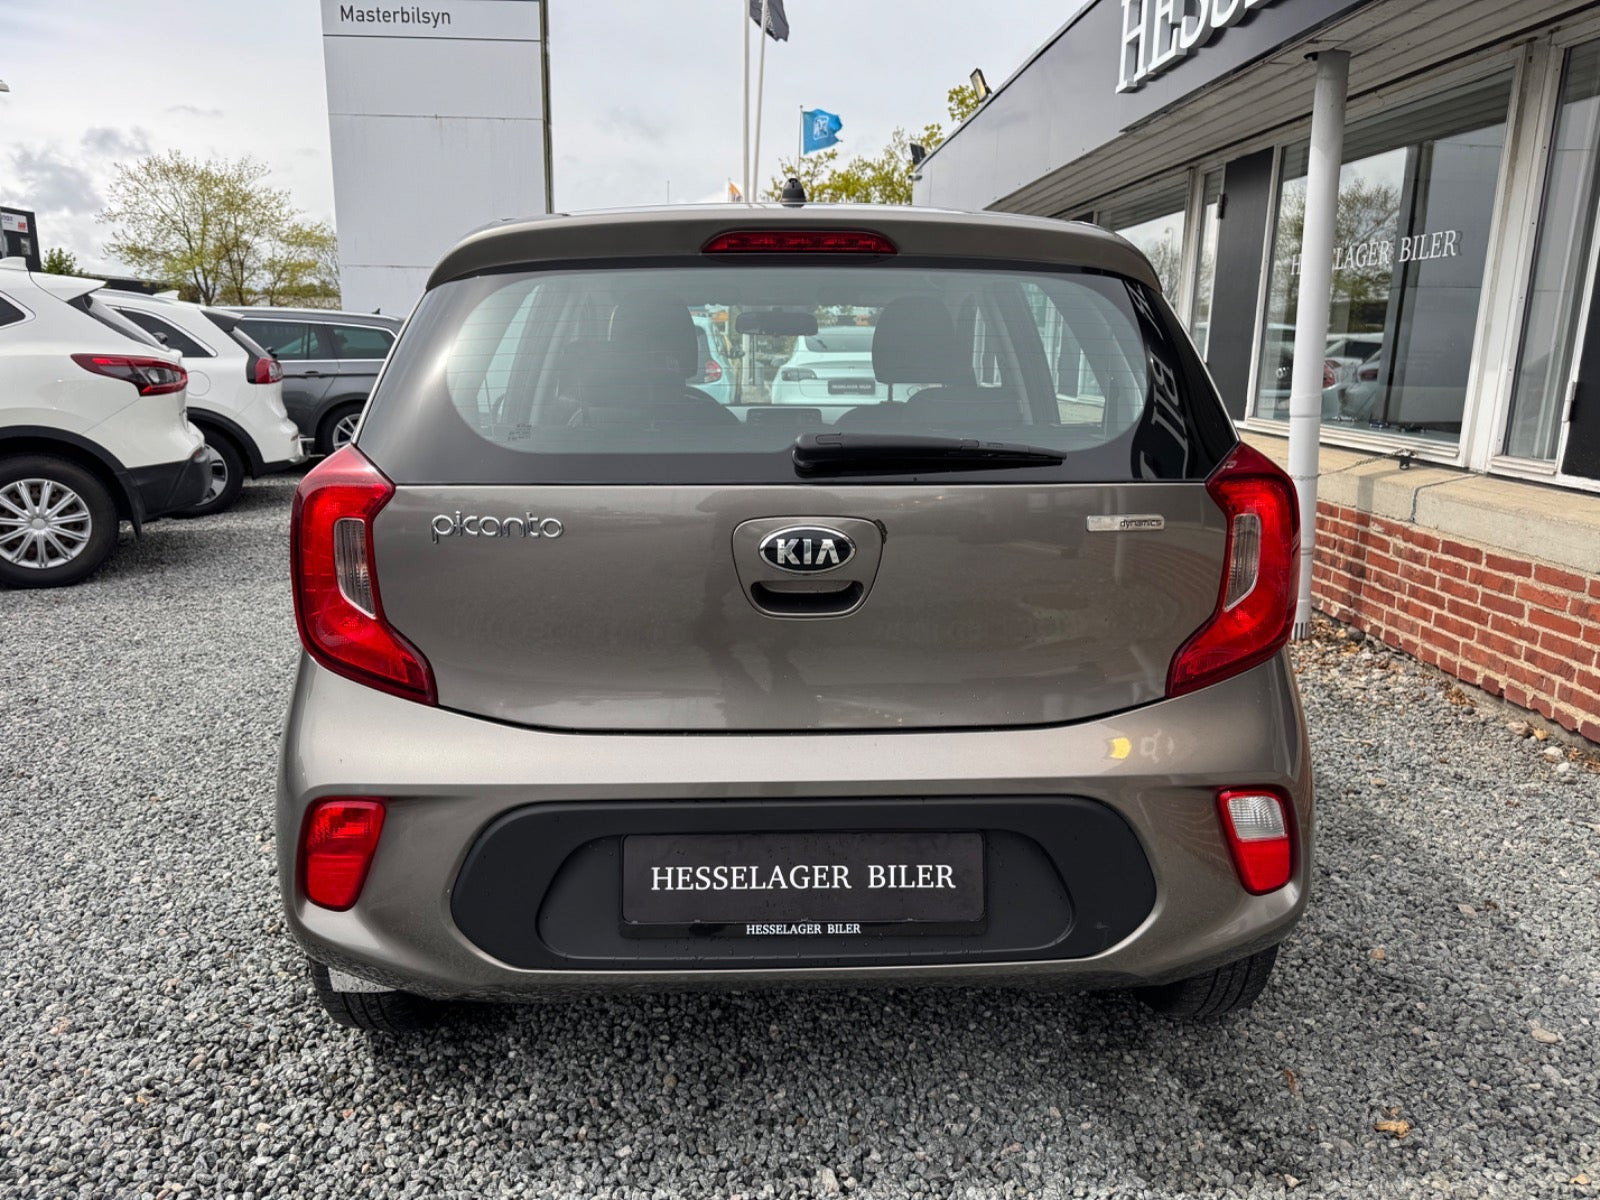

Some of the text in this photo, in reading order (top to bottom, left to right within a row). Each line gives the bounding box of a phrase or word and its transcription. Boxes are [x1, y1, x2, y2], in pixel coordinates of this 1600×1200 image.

[340, 5, 451, 28] Masterbilsyn
[1290, 229, 1457, 277] HLAGER BILER
[431, 510, 563, 544] picanto
[776, 538, 840, 565] KIA
[650, 864, 957, 891] HESSELAGER BILER
[745, 923, 862, 935] HESSELAGER BILER
